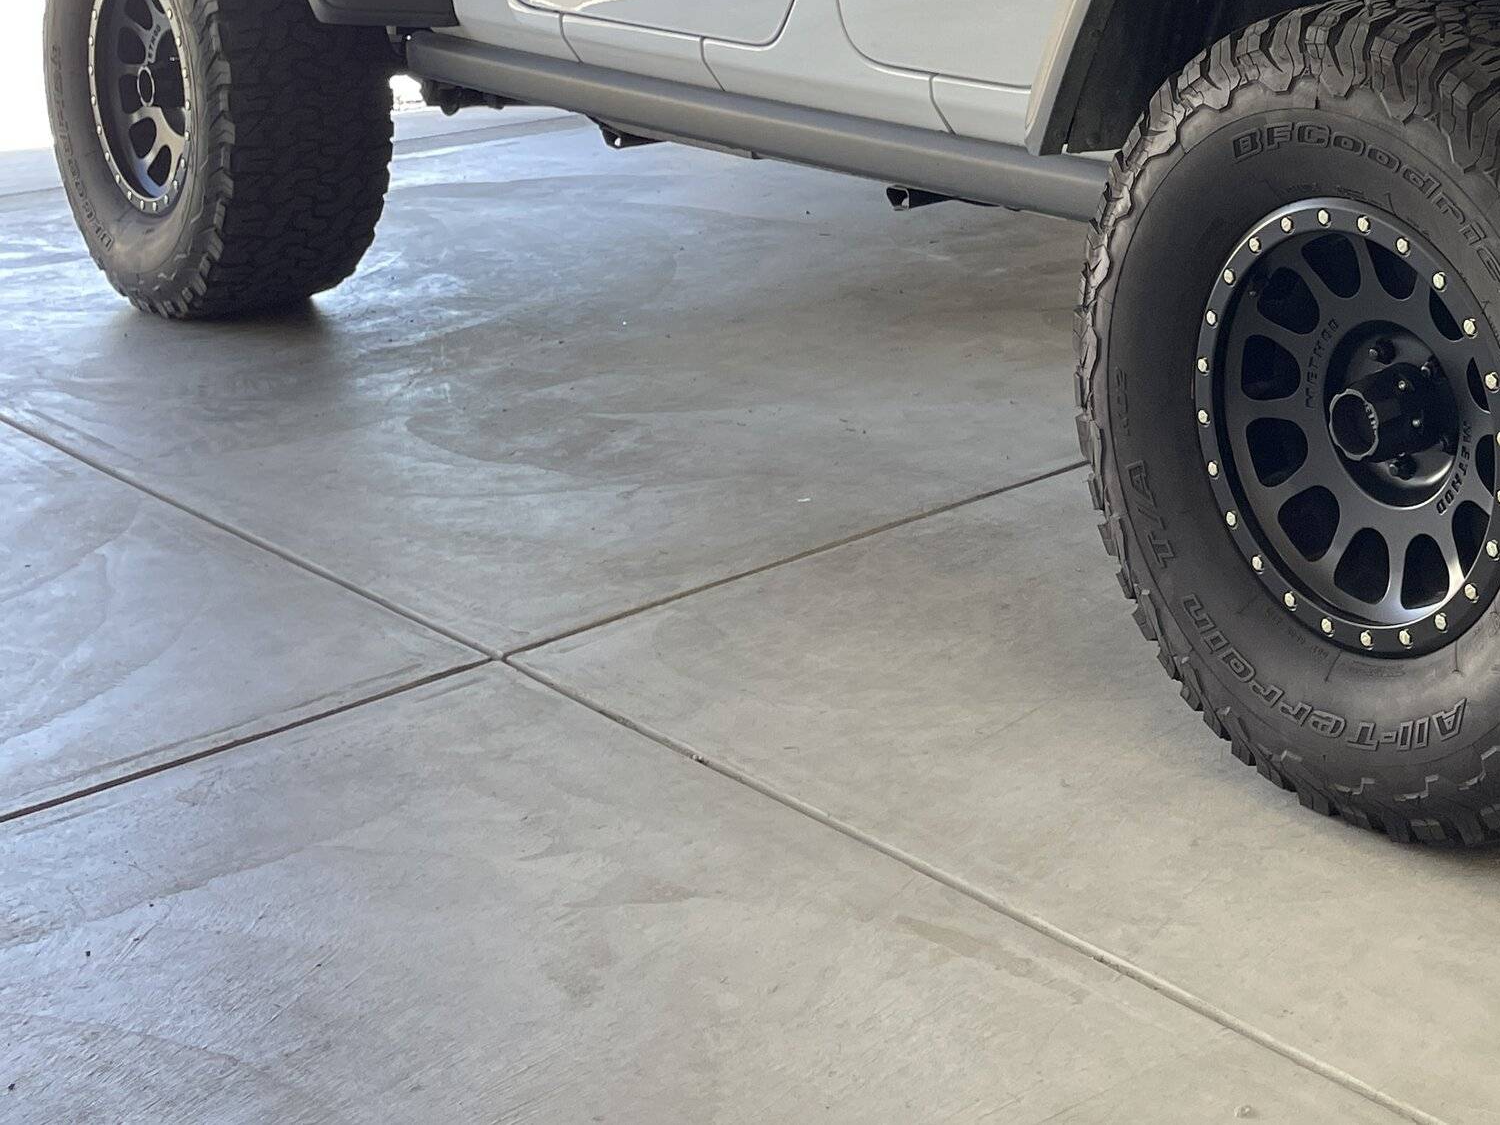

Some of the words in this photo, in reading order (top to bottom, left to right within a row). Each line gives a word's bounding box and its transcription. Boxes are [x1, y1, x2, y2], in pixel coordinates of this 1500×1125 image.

[1125, 459, 1177, 570] T/A
[1435, 421, 1473, 516] METHOD
[1181, 593, 1468, 753] All-Terrain
